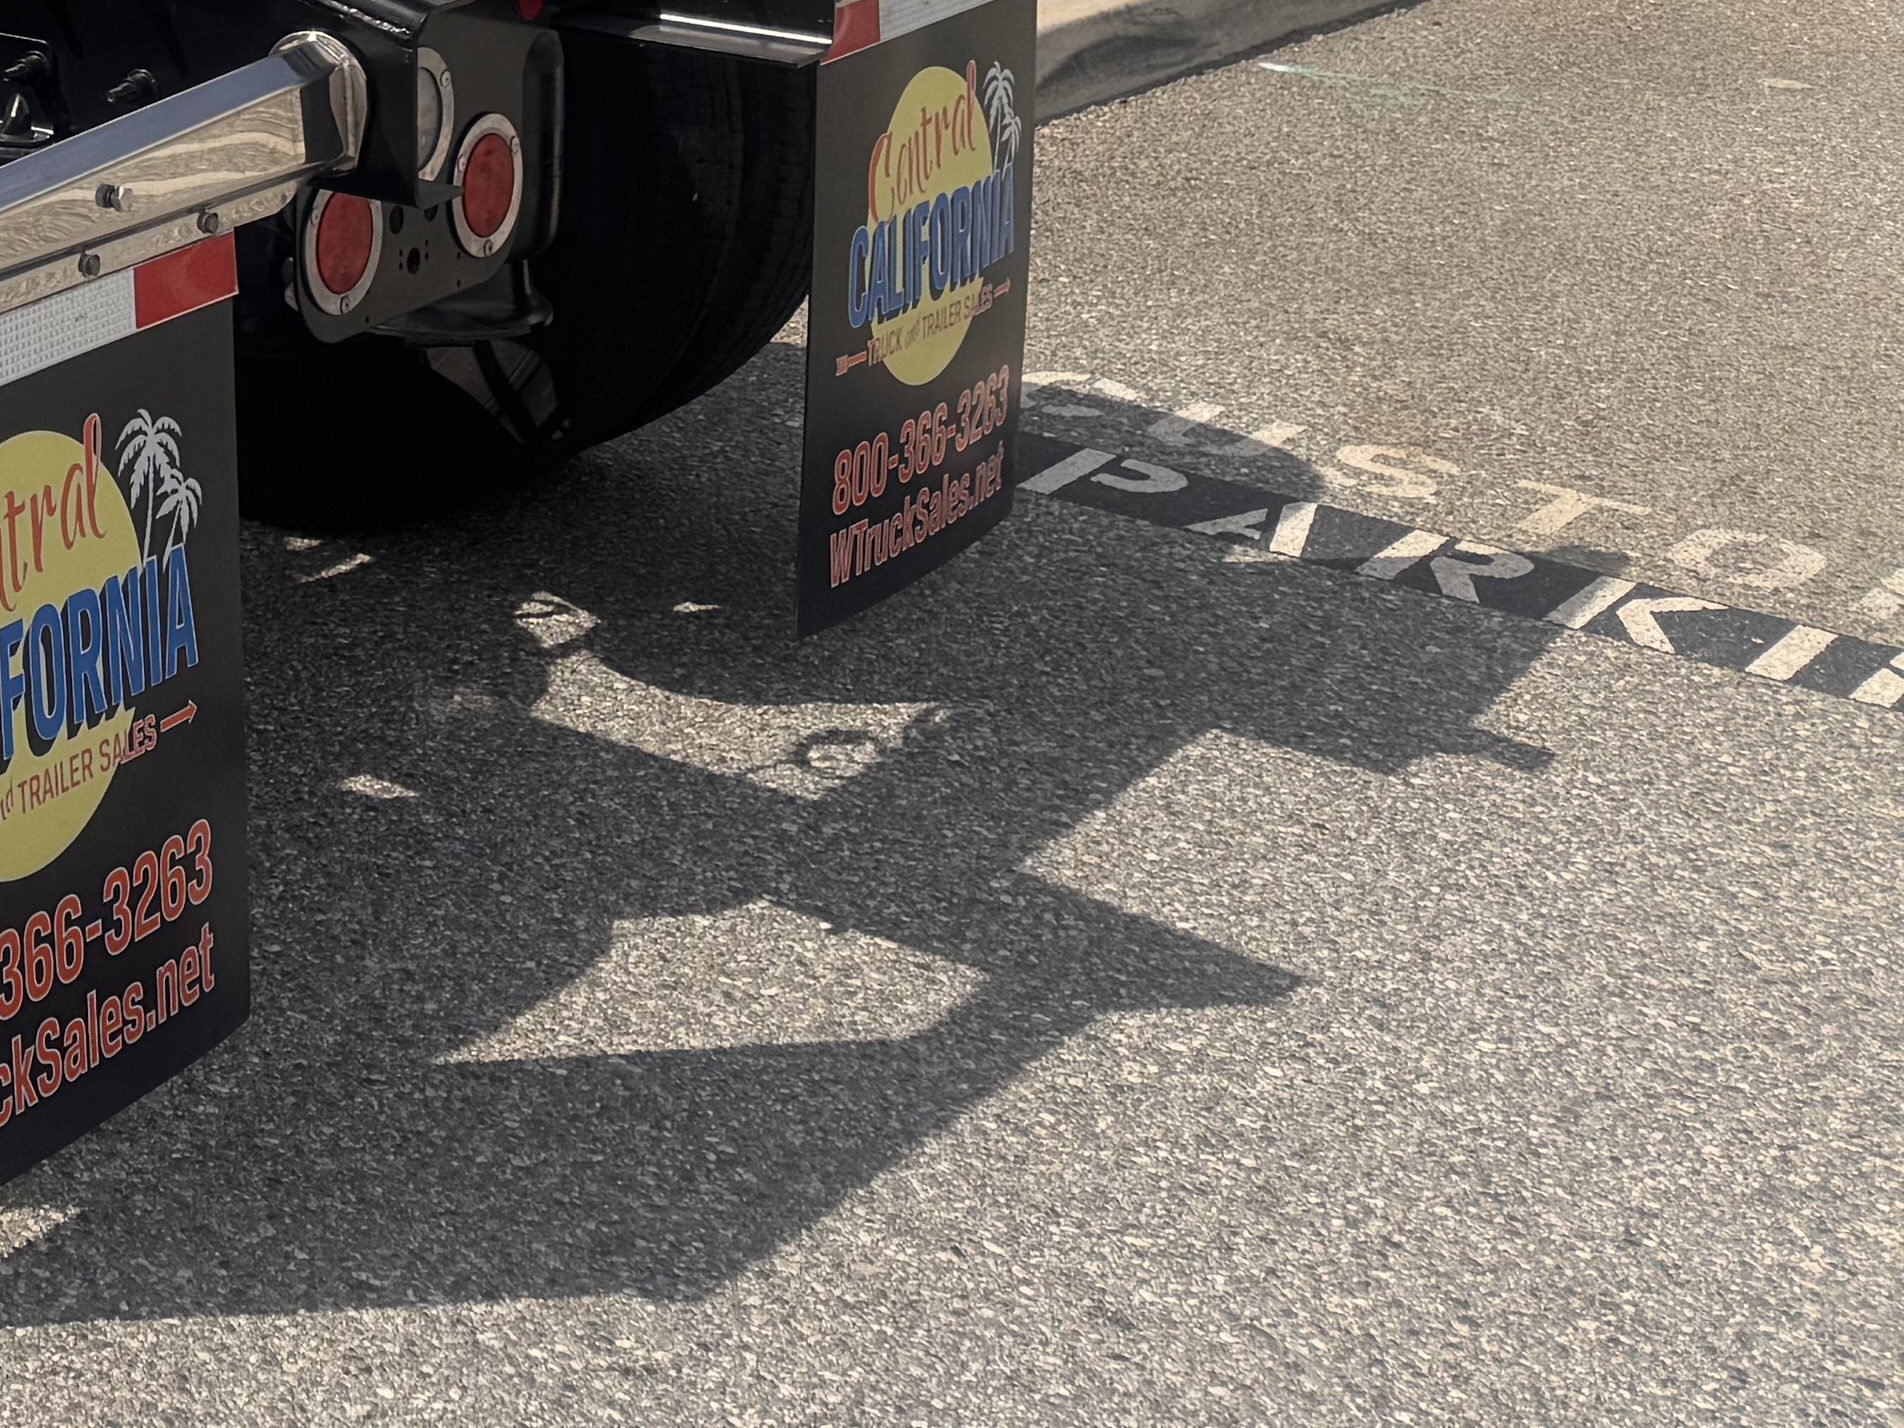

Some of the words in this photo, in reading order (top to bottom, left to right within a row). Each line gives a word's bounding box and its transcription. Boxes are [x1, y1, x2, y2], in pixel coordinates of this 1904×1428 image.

[868, 60, 976, 227] Central
[848, 165, 1014, 330] CALIFORNIA
[867, 325, 903, 366] TRUCK
[921, 300, 962, 341] TRAILER
[963, 284, 994, 320] SALES
[829, 440, 1005, 588] WTruckSales.net
[832, 364, 1009, 516] 800-366-3263
[1020, 370, 1904, 620] CUSTO
[17, 744, 94, 815] TRAILER
[99, 713, 159, 774] SALES
